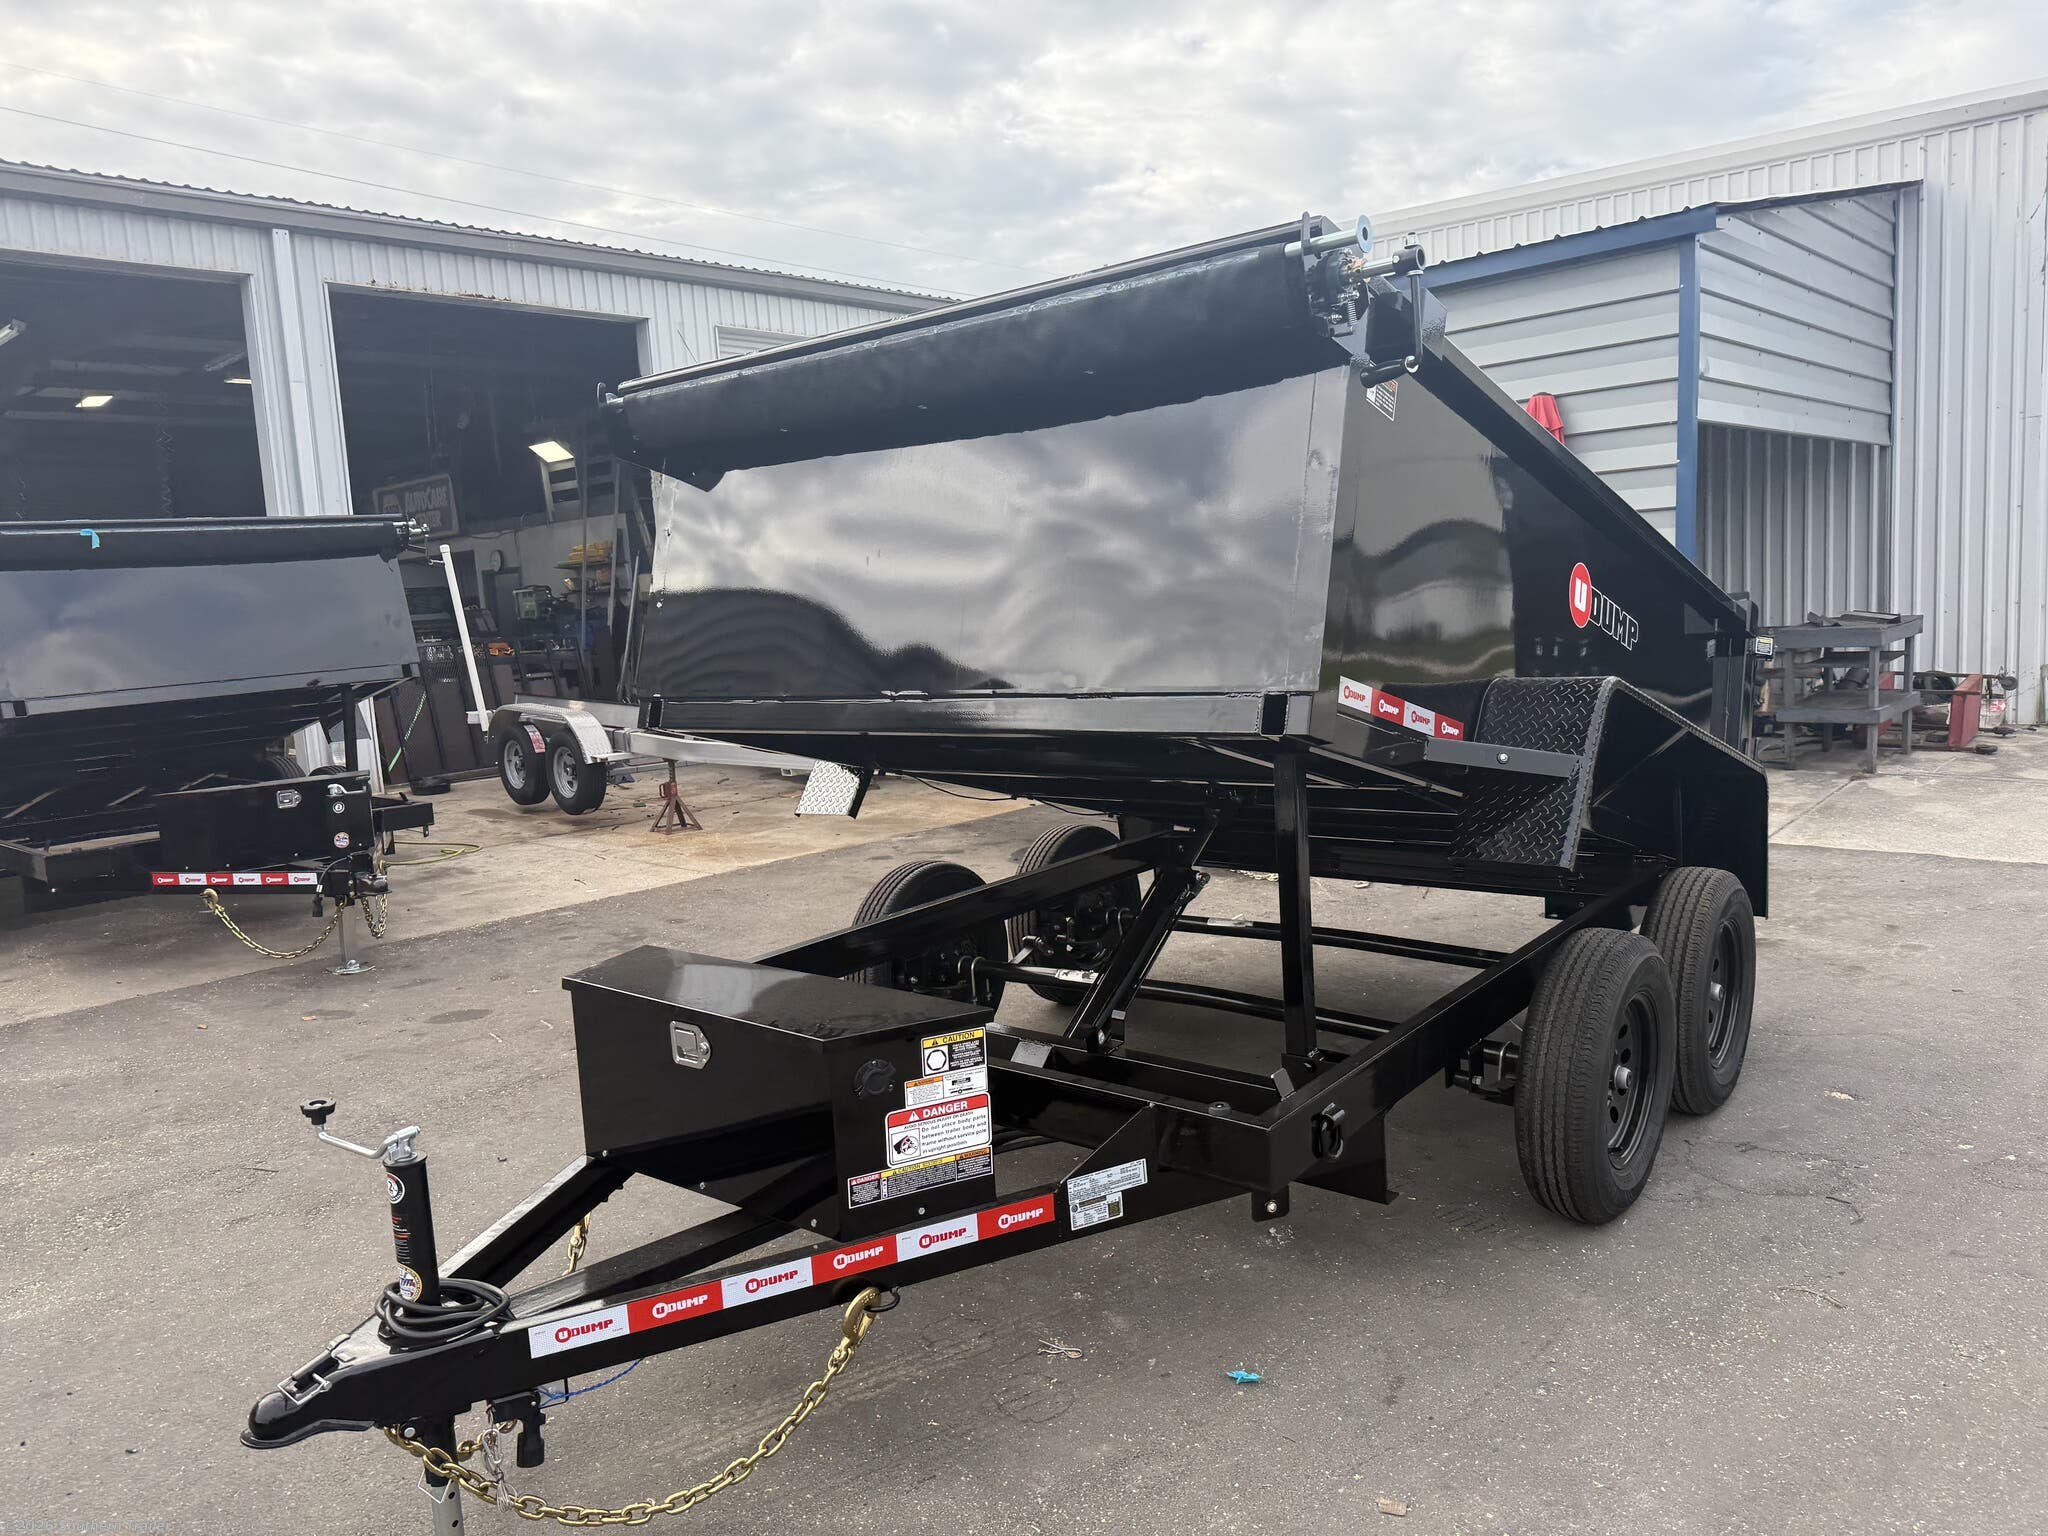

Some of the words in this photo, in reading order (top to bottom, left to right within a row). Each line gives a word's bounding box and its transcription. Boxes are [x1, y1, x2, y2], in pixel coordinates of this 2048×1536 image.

[942, 1032, 974, 1044] CAUTION
[922, 1101, 968, 1118] DANGER
[942, 1121, 956, 1129] place
[958, 1117, 971, 1125] body
[972, 1114, 986, 1122] parts
[922, 1130, 944, 1140] between
[945, 1126, 961, 1134] trailer
[962, 1123, 975, 1131] body
[938, 1135, 957, 1143] without
[958, 1131, 975, 1139] service
[976, 1128, 986, 1136] pole
[928, 1144, 946, 1153] upright
[555, 1319, 614, 1343] UDUMP
[652, 1294, 708, 1318] UDUMP
[745, 1270, 798, 1294] UDUMP
[833, 1246, 884, 1270] UDUMP
[918, 1228, 966, 1248] UDUMP
[998, 1208, 1044, 1228] UDUMP
